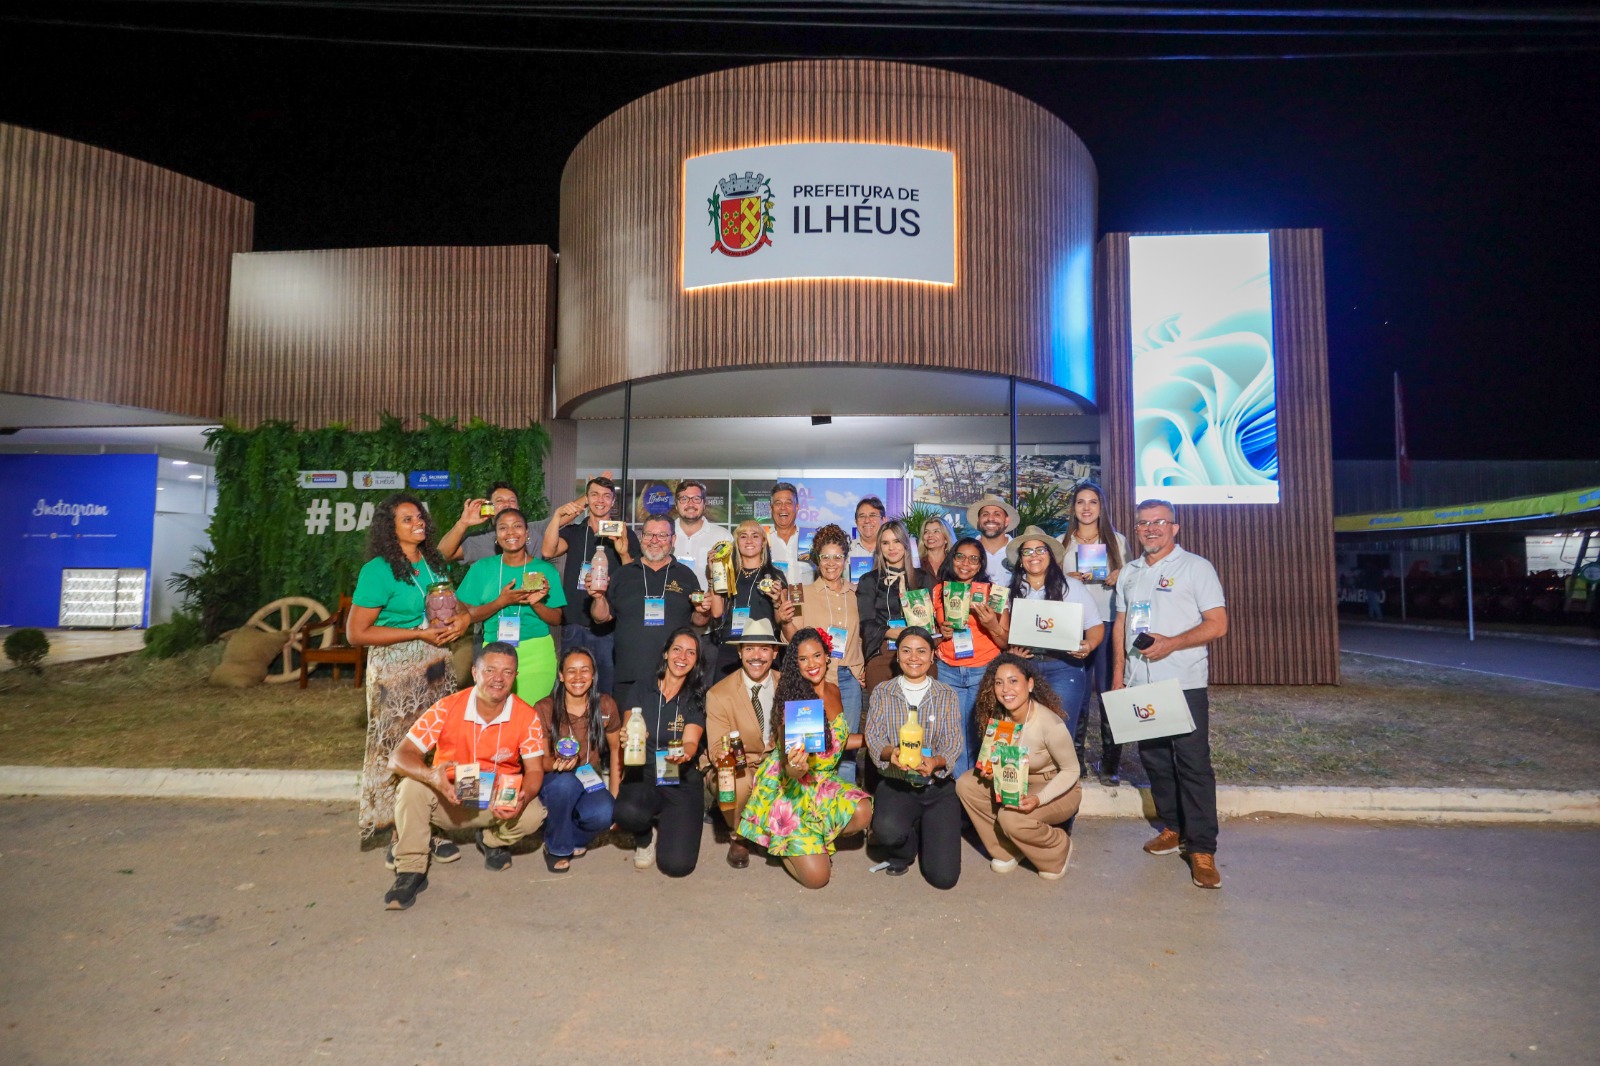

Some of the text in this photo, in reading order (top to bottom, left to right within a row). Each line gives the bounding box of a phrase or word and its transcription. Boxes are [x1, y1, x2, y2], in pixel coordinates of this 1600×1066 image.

[793, 184, 920, 202] PREFEITURA DE
[793, 199, 921, 237] ILHÉUS
[797, 487, 815, 499] AL
[32, 498, 110, 526] Instagram
[796, 510, 820, 523] OR
[1035, 613, 1055, 631] ibs
[1132, 703, 1156, 720] ibs
[1002, 770, 1018, 780] COCO
